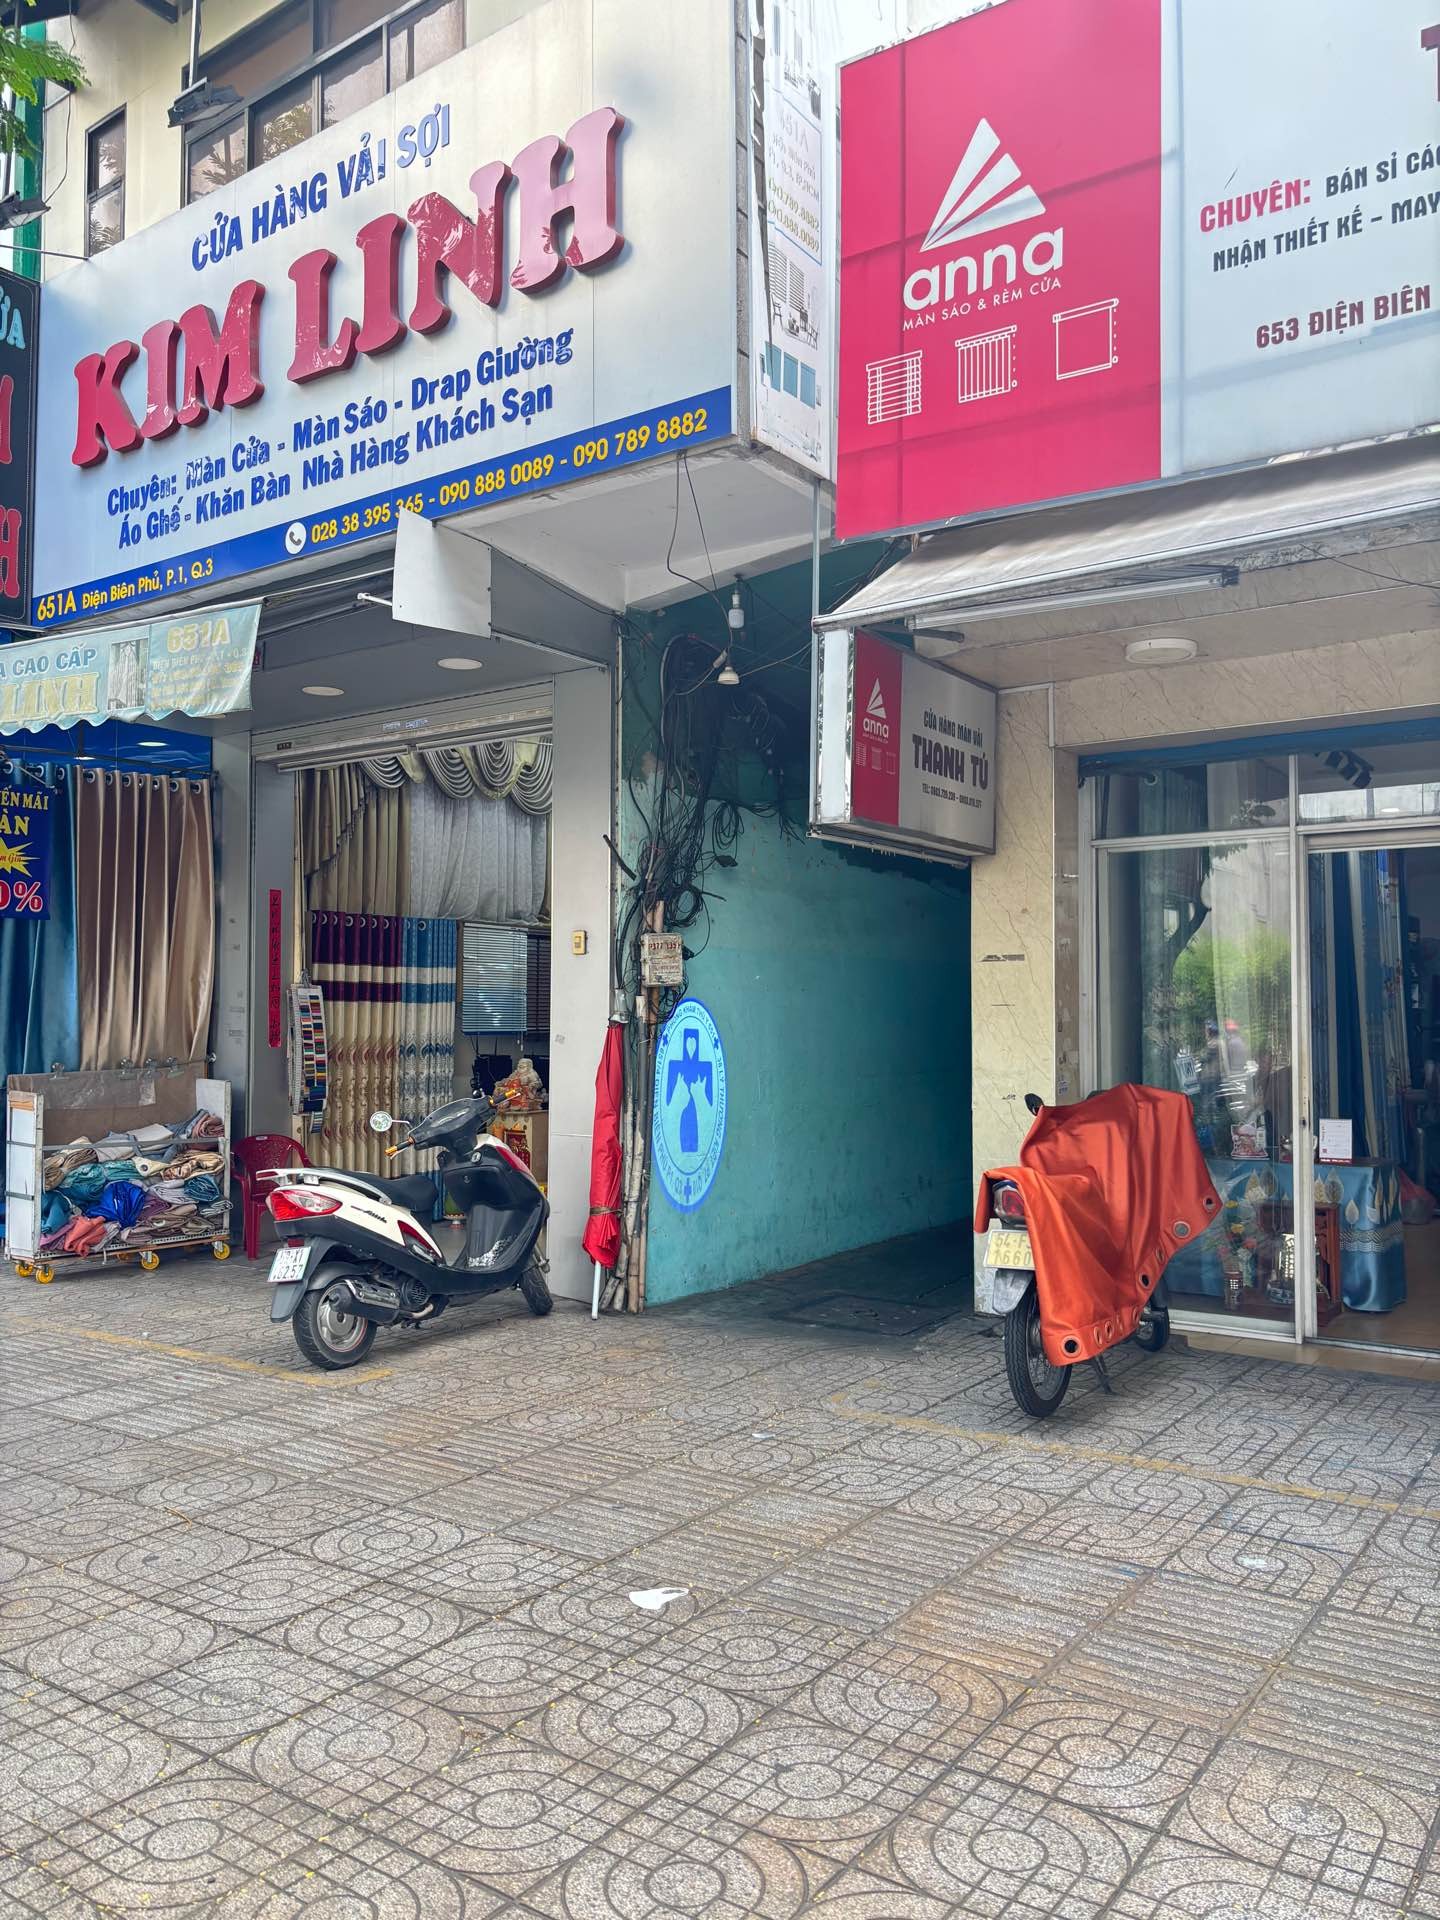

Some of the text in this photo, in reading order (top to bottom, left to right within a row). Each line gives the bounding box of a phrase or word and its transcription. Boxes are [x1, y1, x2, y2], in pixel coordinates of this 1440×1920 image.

[191, 102, 451, 271] CỬA HÀNG VẢI SỢI
[1200, 178, 1311, 232] CHUYÊN:
[1325, 166, 1368, 198] BÁN
[1376, 152, 1397, 183] SỈ
[1213, 238, 1267, 273] NHẬN
[1274, 217, 1329, 256] THIẾT
[1337, 204, 1363, 239] KẾ
[1391, 190, 1440, 225] MAY
[71, 107, 626, 468] KIM LINH
[903, 227, 1064, 311] anna
[903, 276, 1062, 331] MÀN SÁO & RÈM CỬA
[1256, 284, 1431, 349] 653 ĐIỆN BIÊN
[107, 474, 177, 516] Chuyên:
[186, 455, 226, 490] Màn
[232, 435, 270, 473] Cửa
[293, 414, 340, 452] Màn
[343, 396, 387, 434] Sáo
[411, 368, 471, 411] Drap
[476, 327, 574, 386] Giường
[119, 513, 141, 550] Áo
[146, 496, 183, 539] Ghế
[196, 487, 245, 524] Khăn
[251, 472, 290, 506] Bàn
[302, 450, 343, 490] Nhà
[350, 431, 410, 474] Hàng
[416, 396, 495, 453] Khách
[502, 384, 553, 425] Sạn
[311, 519, 338, 543] 028
[341, 512, 359, 535] 38
[364, 503, 391, 528] 395
[439, 479, 470, 506] 090
[475, 468, 506, 496] 888
[511, 454, 554, 486] 0089
[573, 438, 609, 467] 090
[614, 425, 650, 456] 789
[656, 408, 708, 444] 8882
[37, 558, 214, 622] 651A Điện Biên Phủ, P.1, Q.3
[13, 655, 50, 676] CAO
[56, 642, 97, 670] CẤP
[167, 618, 231, 653] 651A
[863, 718, 888, 738] anna
[923, 707, 937, 730] CỬA
[939, 714, 956, 738] HÀNG
[957, 723, 971, 743] MÀN
[912, 733, 989, 790] THANH TÚ
[0, 785, 49, 810] ẾN MÃI
